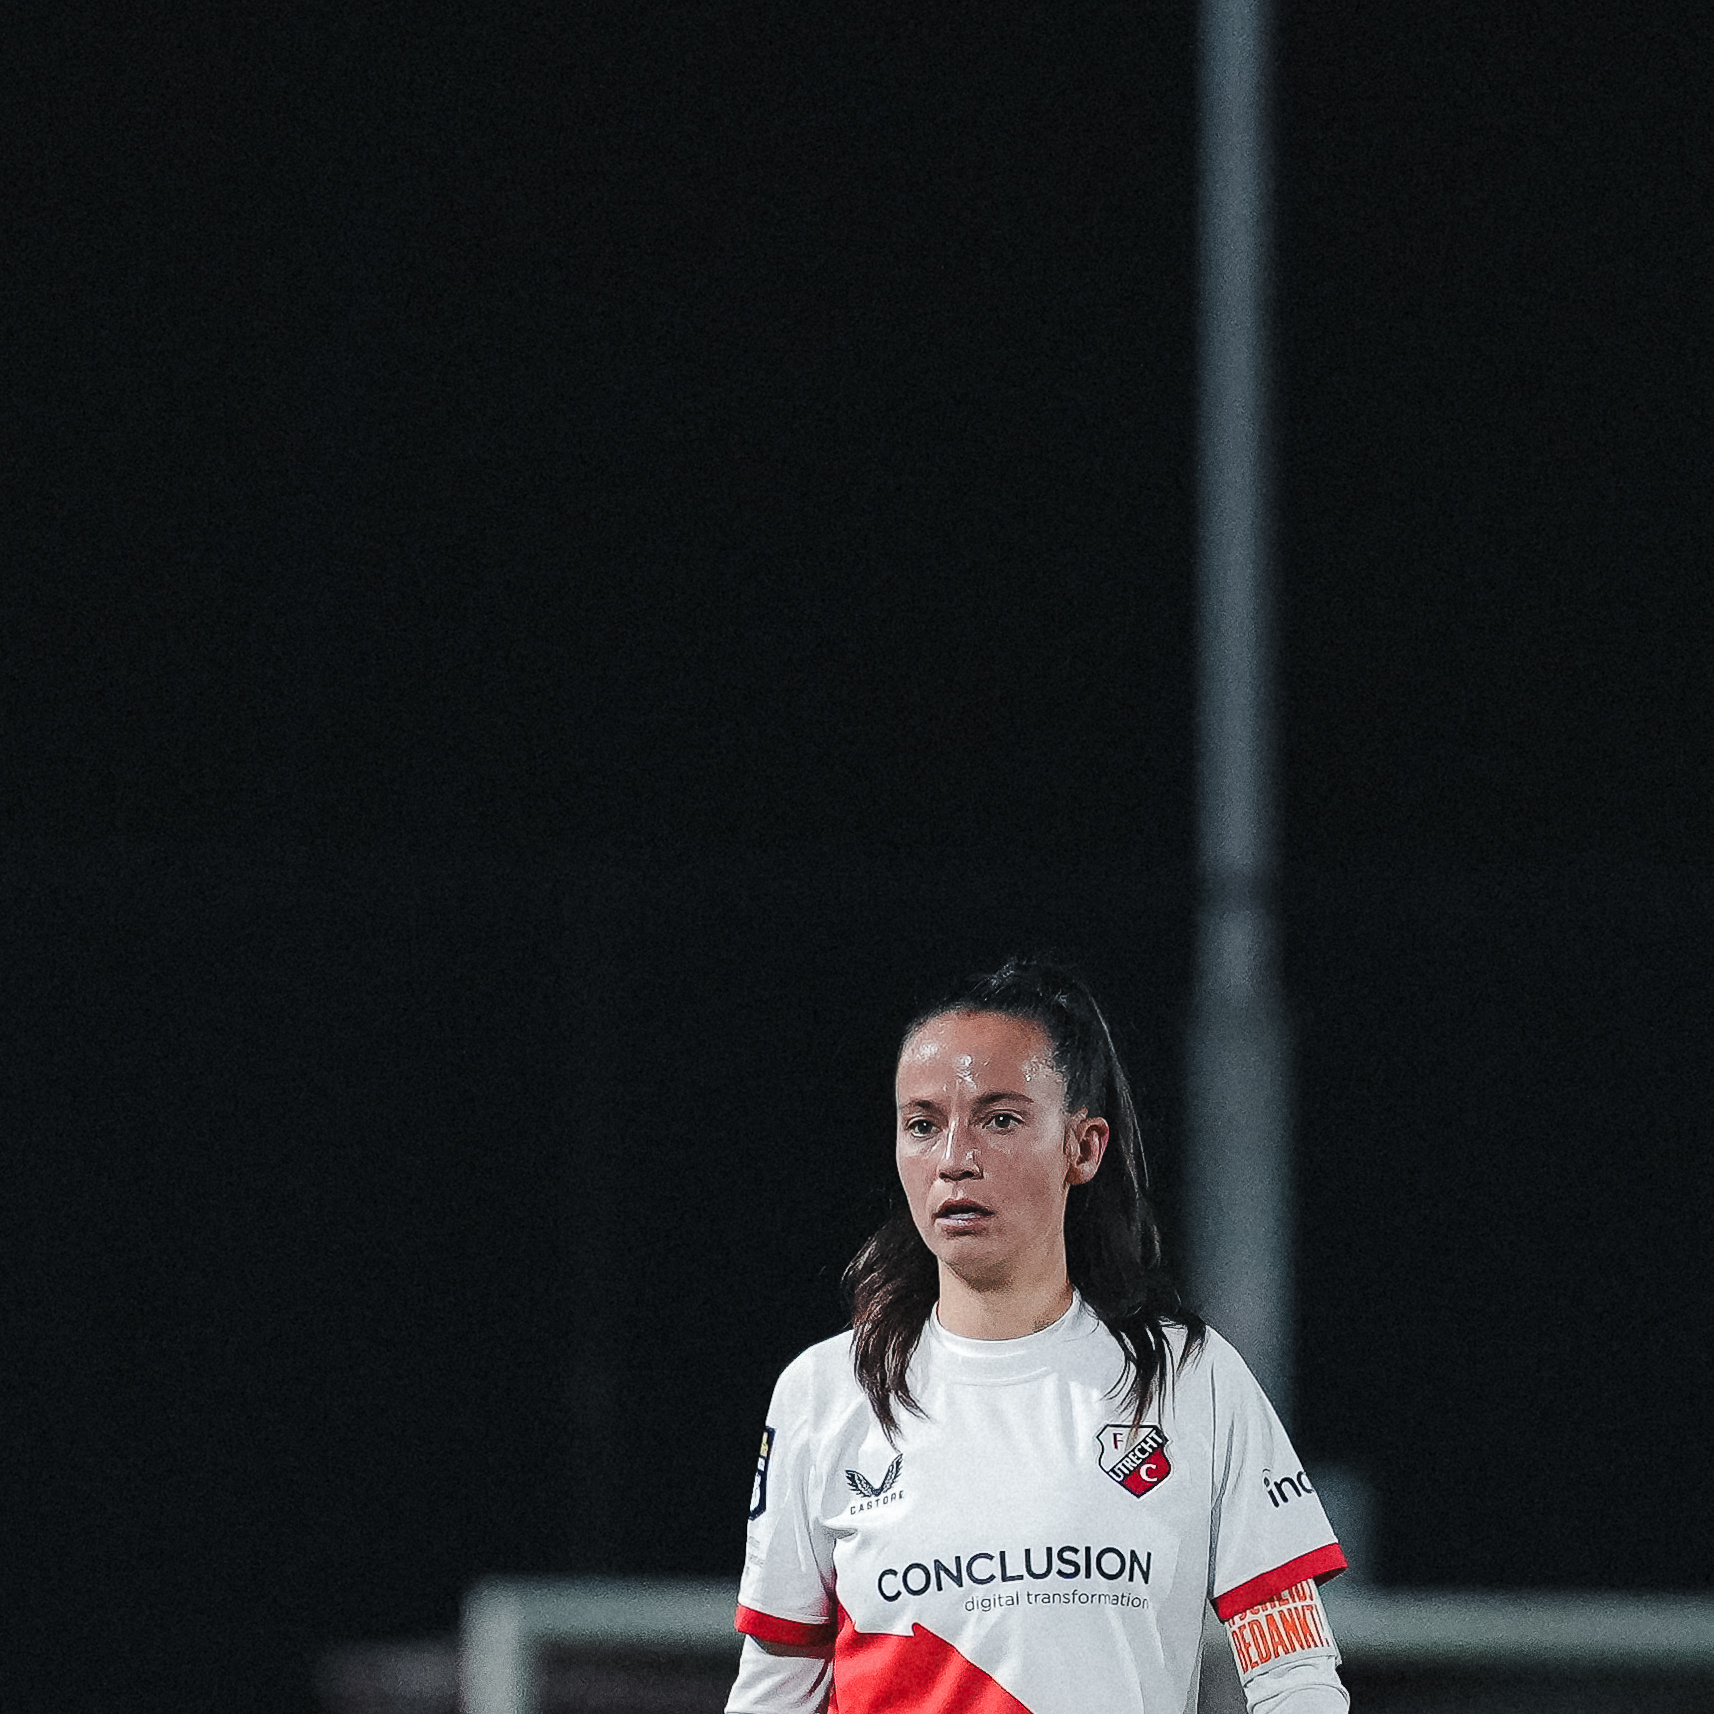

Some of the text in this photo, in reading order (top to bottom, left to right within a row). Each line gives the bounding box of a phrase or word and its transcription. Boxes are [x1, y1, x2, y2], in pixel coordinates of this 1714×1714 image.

[1108, 1429, 1163, 1482] UTRECHT
[1139, 1463, 1158, 1482] C
[850, 1490, 905, 1515] CASTORE
[877, 1545, 1152, 1602] CONCLUSION
[964, 1589, 1150, 1612] digital transformation
